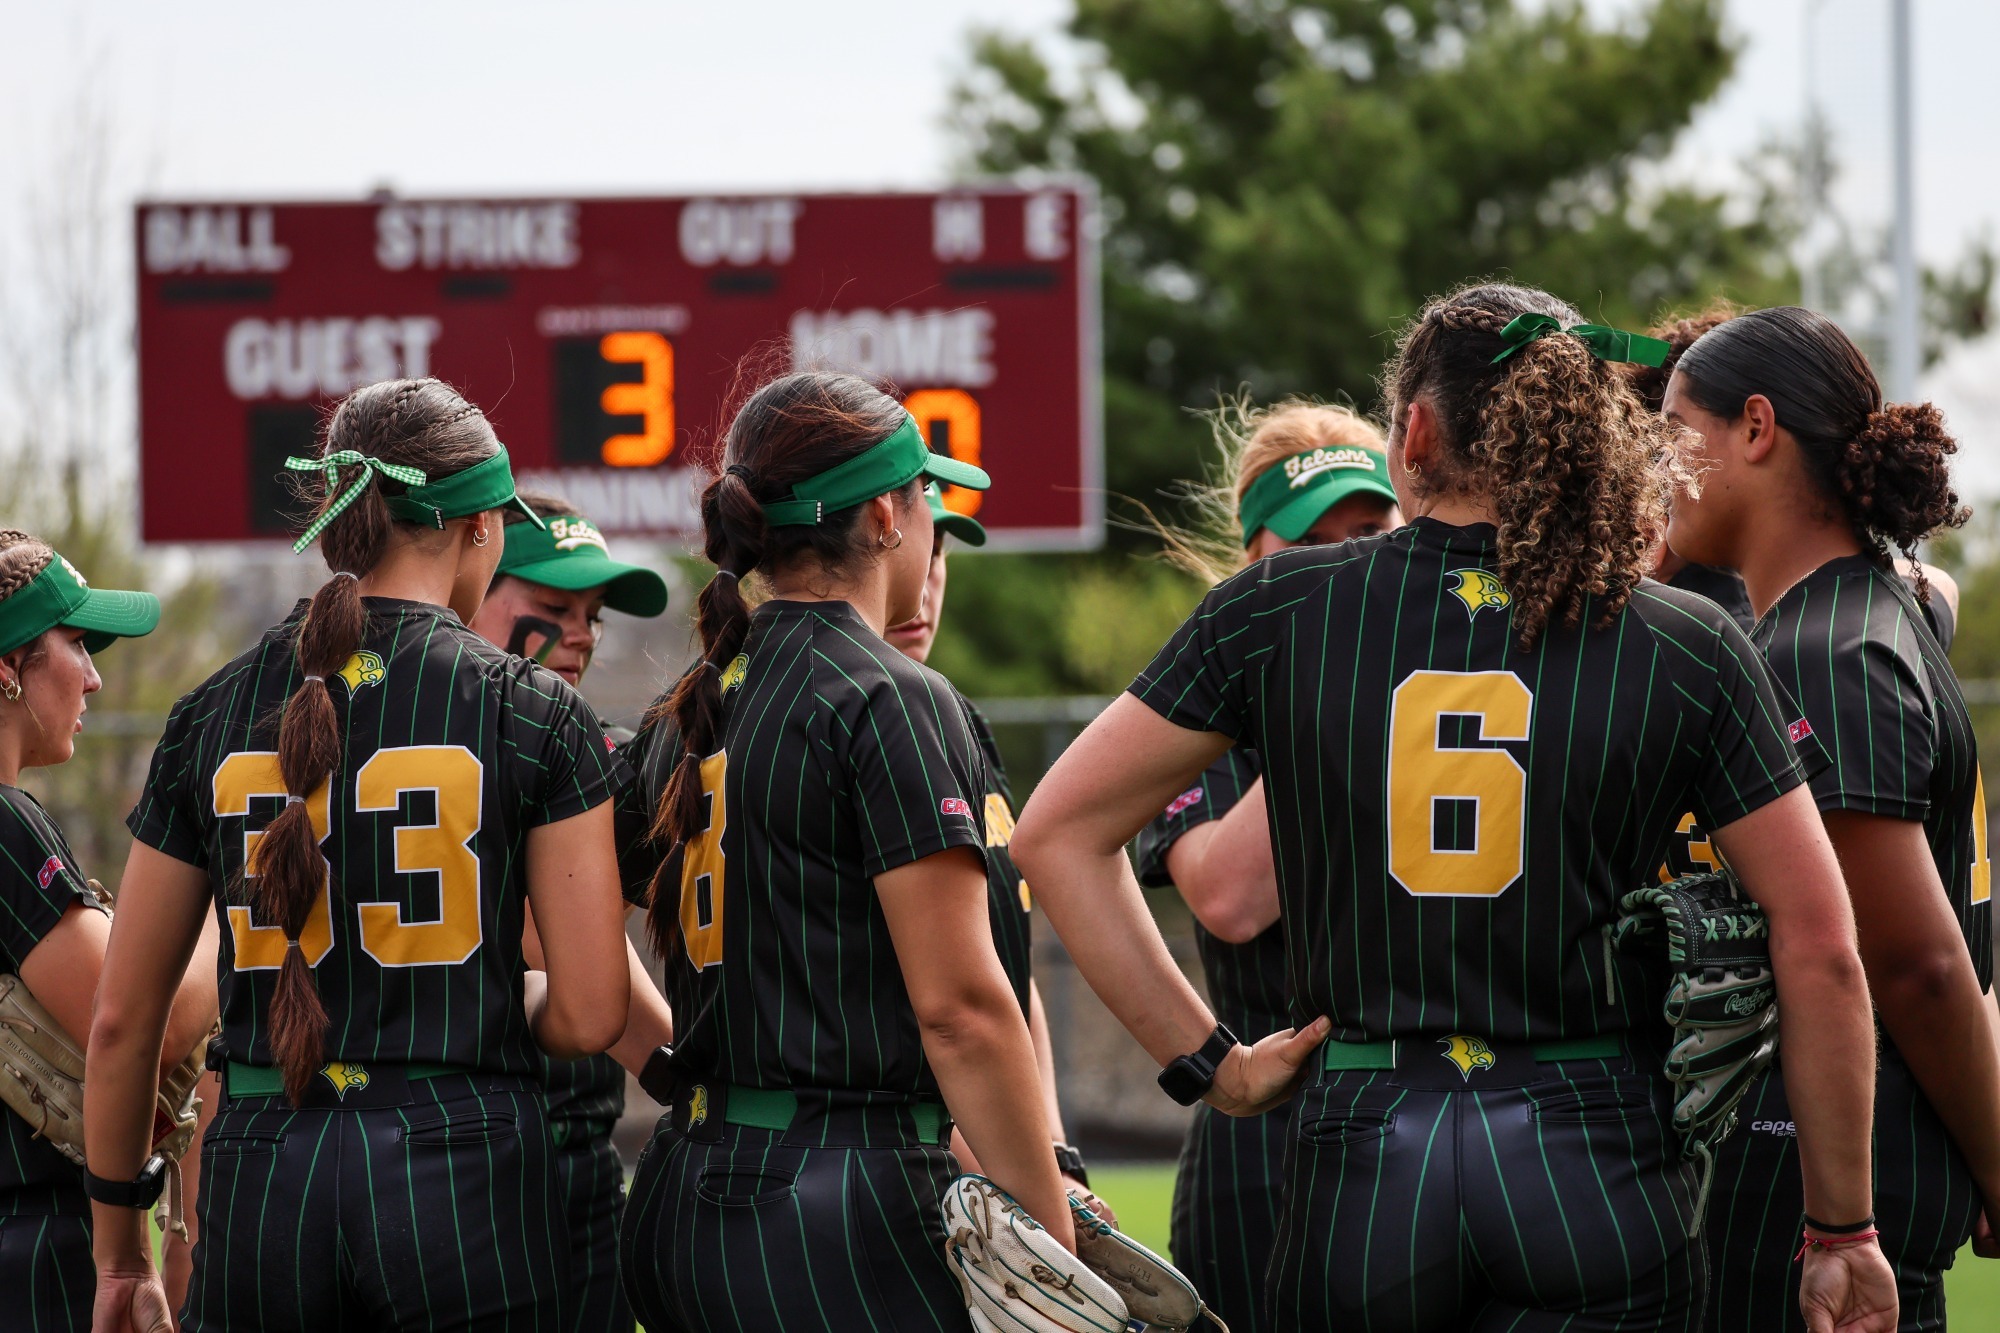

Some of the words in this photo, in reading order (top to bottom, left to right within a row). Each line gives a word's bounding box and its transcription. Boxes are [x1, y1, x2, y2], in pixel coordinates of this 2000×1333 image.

[145, 206, 289, 273] BALL
[375, 205, 580, 270] STRIKE
[679, 203, 801, 265] OUT
[1024, 198, 1069, 260] E
[225, 318, 439, 398] GUEST
[790, 309, 995, 387] HOME
[600, 331, 676, 467] 3
[1284, 448, 1373, 482] Falcons
[1387, 670, 1533, 897] 6
[213, 745, 483, 972] 33
[679, 748, 727, 973] 8
[19, 1049, 37, 1066] GOLD
[1751, 1121, 1796, 1135] cape
